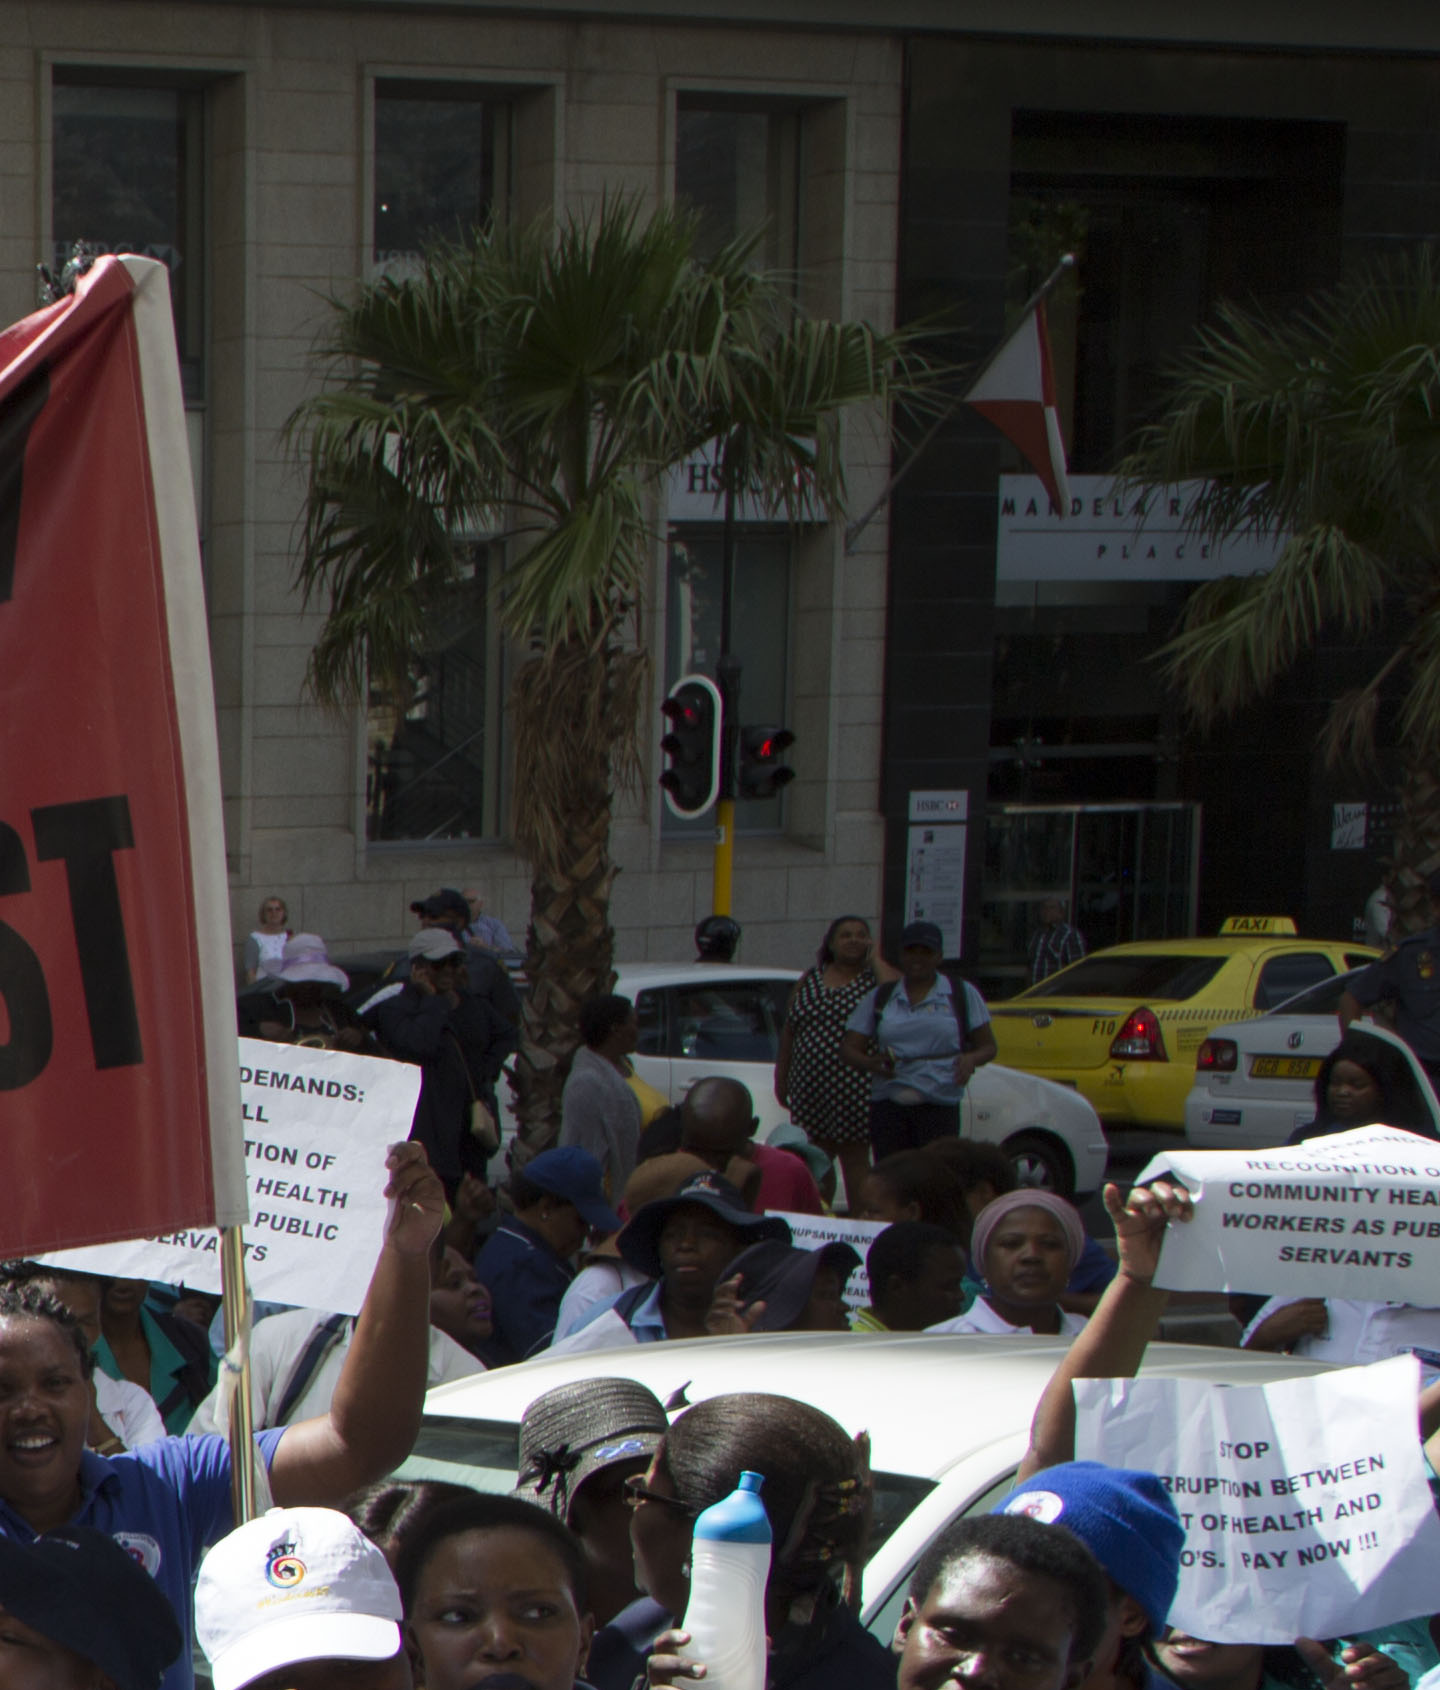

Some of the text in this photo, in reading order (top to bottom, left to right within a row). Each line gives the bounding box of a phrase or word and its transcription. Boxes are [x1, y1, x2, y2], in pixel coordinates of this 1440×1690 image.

[1097, 545, 1210, 559] PLACE
[1230, 919, 1269, 931] TAXI
[1091, 1019, 1117, 1036] F10
[239, 1066, 365, 1103] DEMANDS:
[305, 1151, 337, 1172] OF
[1245, 1159, 1418, 1176] RECOGNITION
[255, 1176, 349, 1209] HEALTH
[1229, 1181, 1380, 1204] COMMUNITY
[253, 1211, 340, 1242] PUBLIC
[1221, 1212, 1386, 1236] WORKERS AS
[1278, 1245, 1413, 1268] SERVANTS
[1219, 1440, 1271, 1460] STOP
[1271, 1453, 1385, 1498] BETWEEN
[1231, 1506, 1324, 1536] HEALTH
[1334, 1492, 1382, 1521] AND
[1180, 1530, 1379, 1571] O'S. PAY NOW !!!
